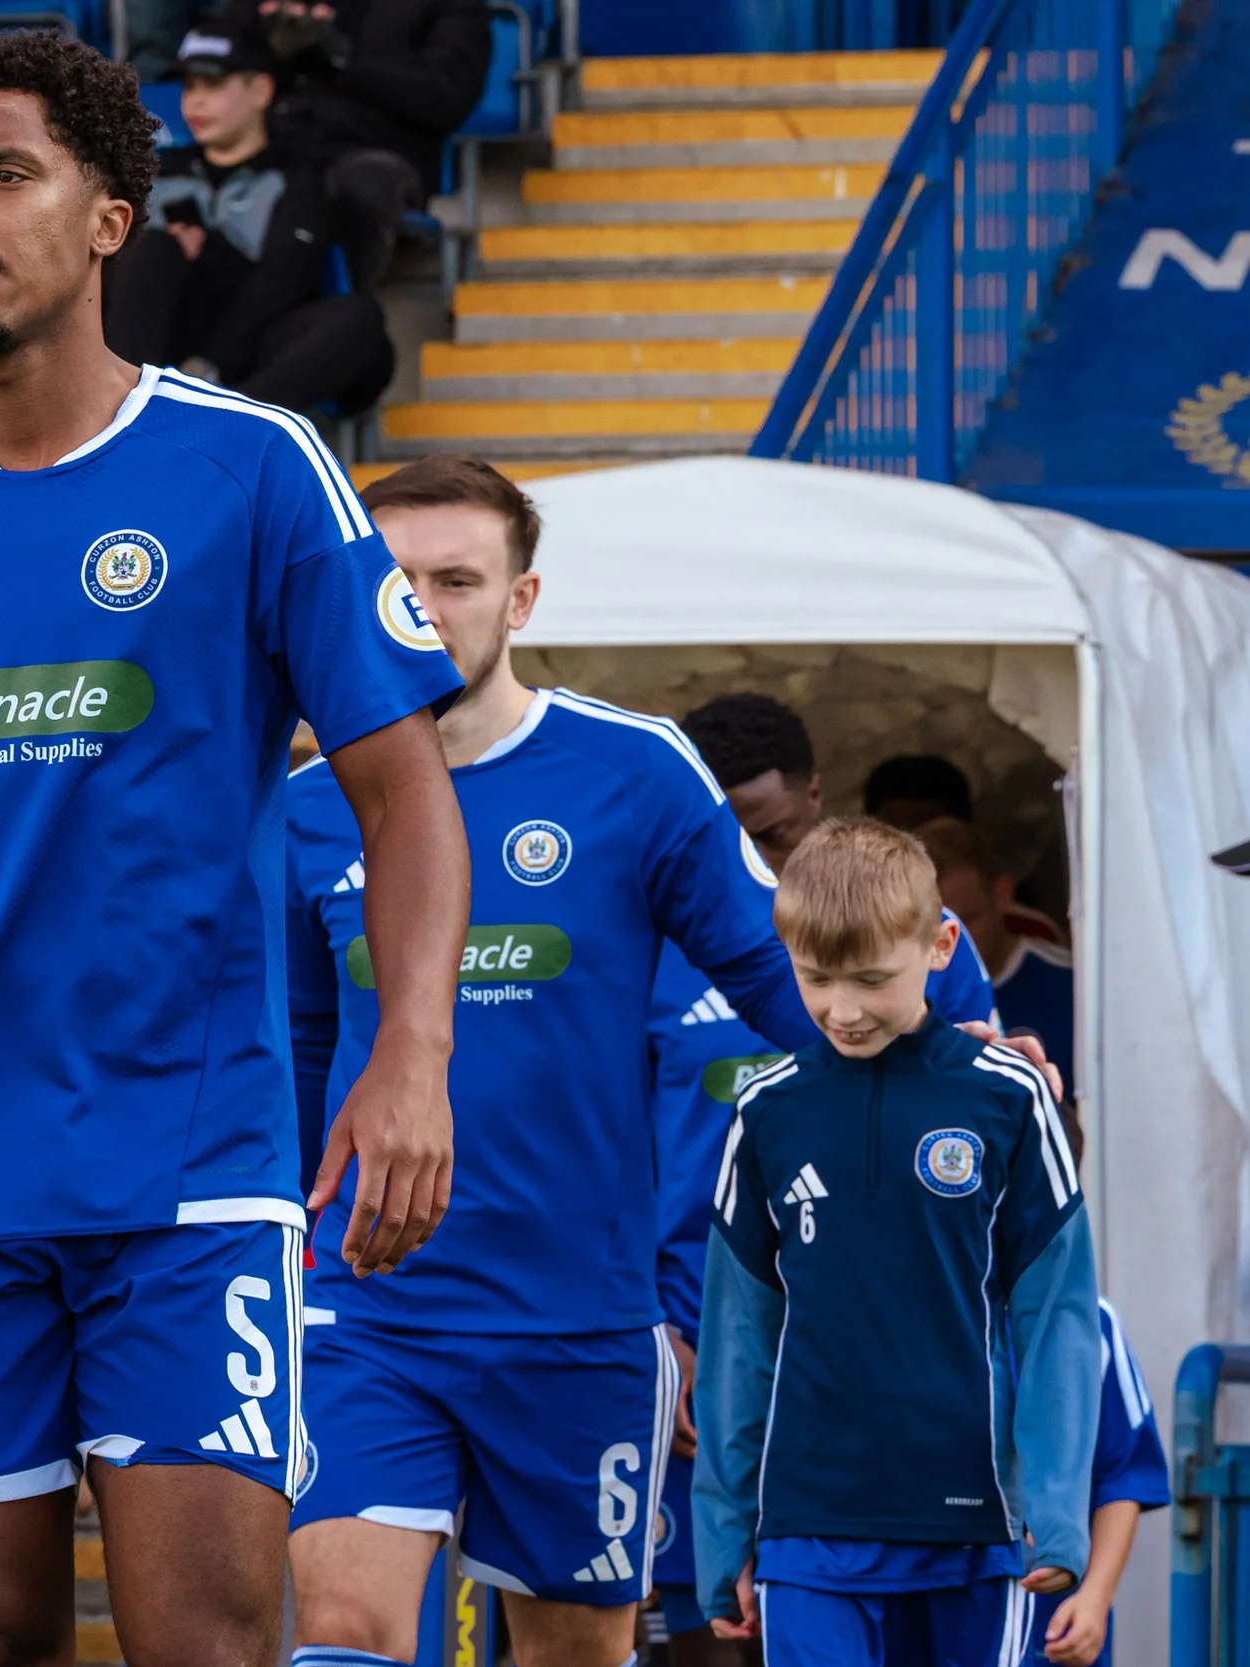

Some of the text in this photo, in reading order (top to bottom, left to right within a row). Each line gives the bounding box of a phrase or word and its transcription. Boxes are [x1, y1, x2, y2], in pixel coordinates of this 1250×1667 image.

[89, 534, 161, 563] CURZON ASHTON
[88, 578, 158, 604] FOOTBALL CLUB
[21, 737, 103, 765] Supplies
[459, 935, 533, 971] acle
[461, 985, 533, 1005] Supplies
[800, 1201, 816, 1244] 6
[598, 1442, 640, 1537] 6
